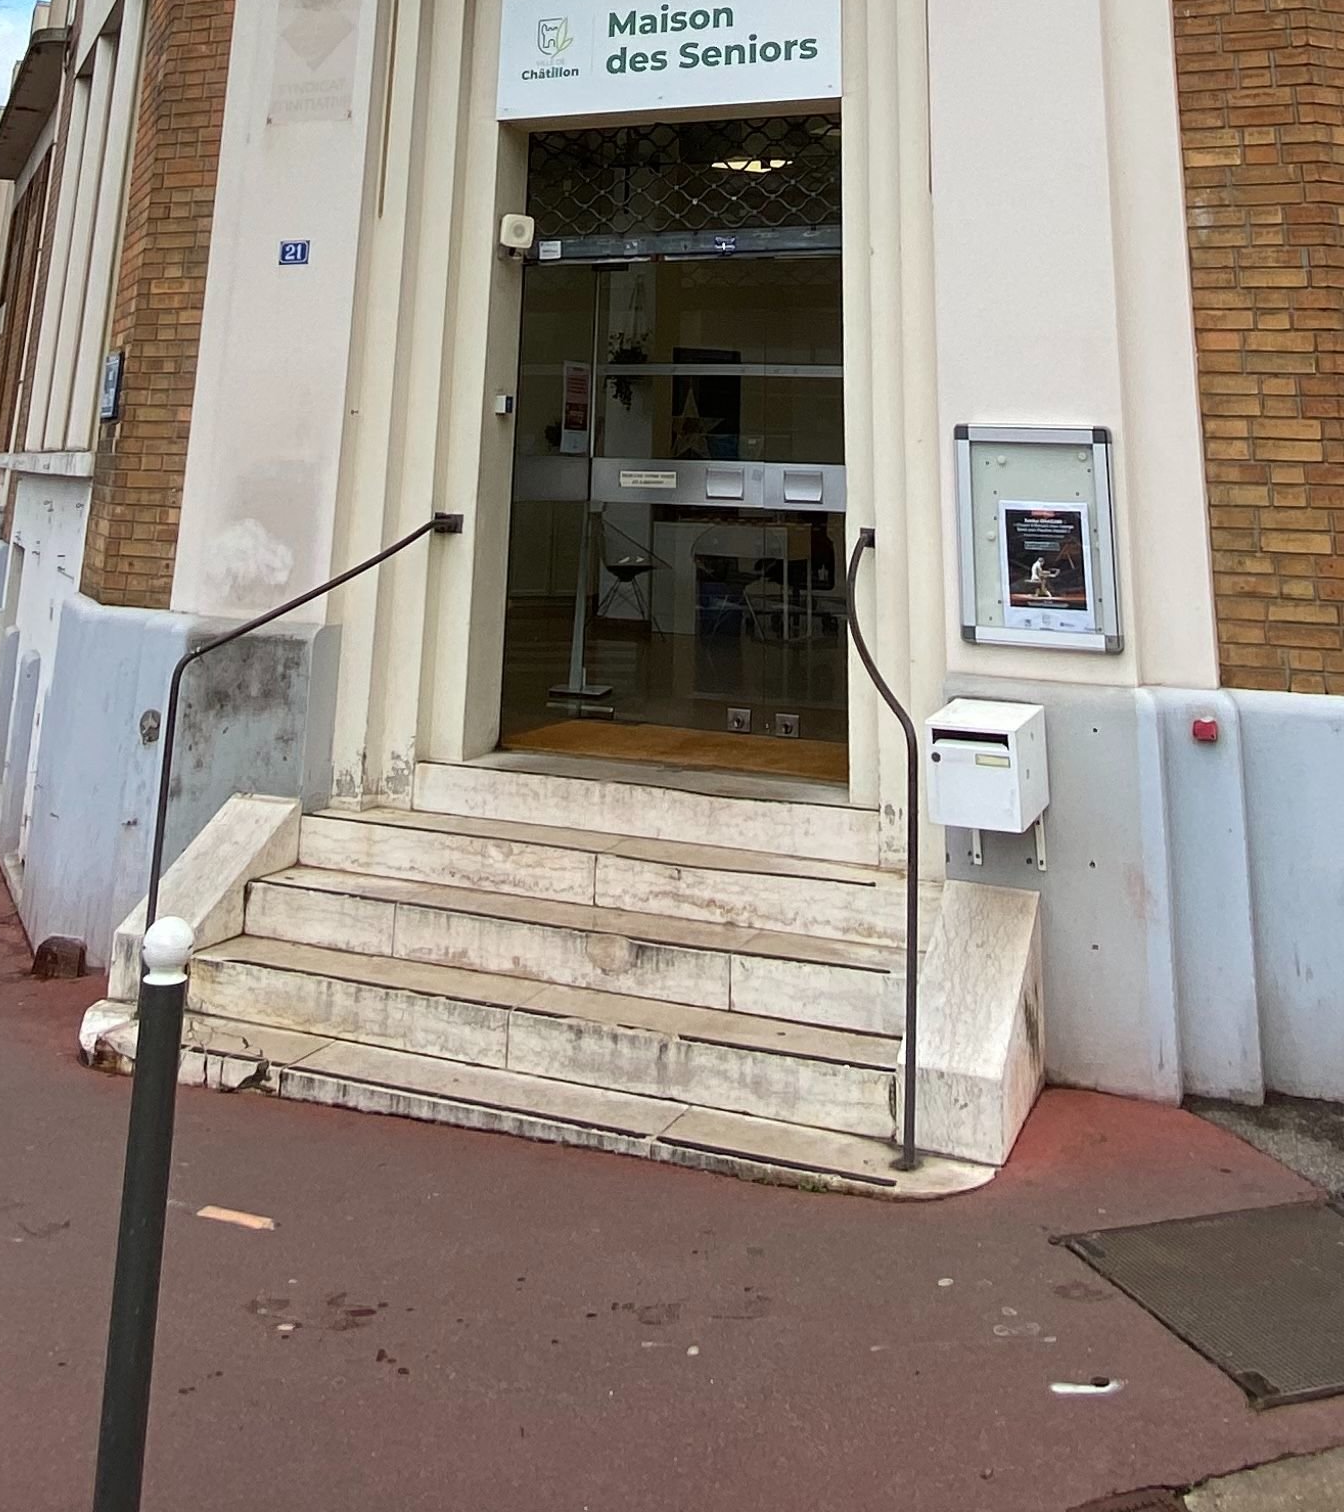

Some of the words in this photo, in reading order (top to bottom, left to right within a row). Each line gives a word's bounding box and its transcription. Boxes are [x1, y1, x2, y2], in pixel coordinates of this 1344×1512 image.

[607, 4, 734, 38] Maison
[605, 46, 668, 75] des
[678, 34, 818, 69] Seniors
[521, 66, 579, 81] Châtillon
[285, 243, 302, 260] 21
